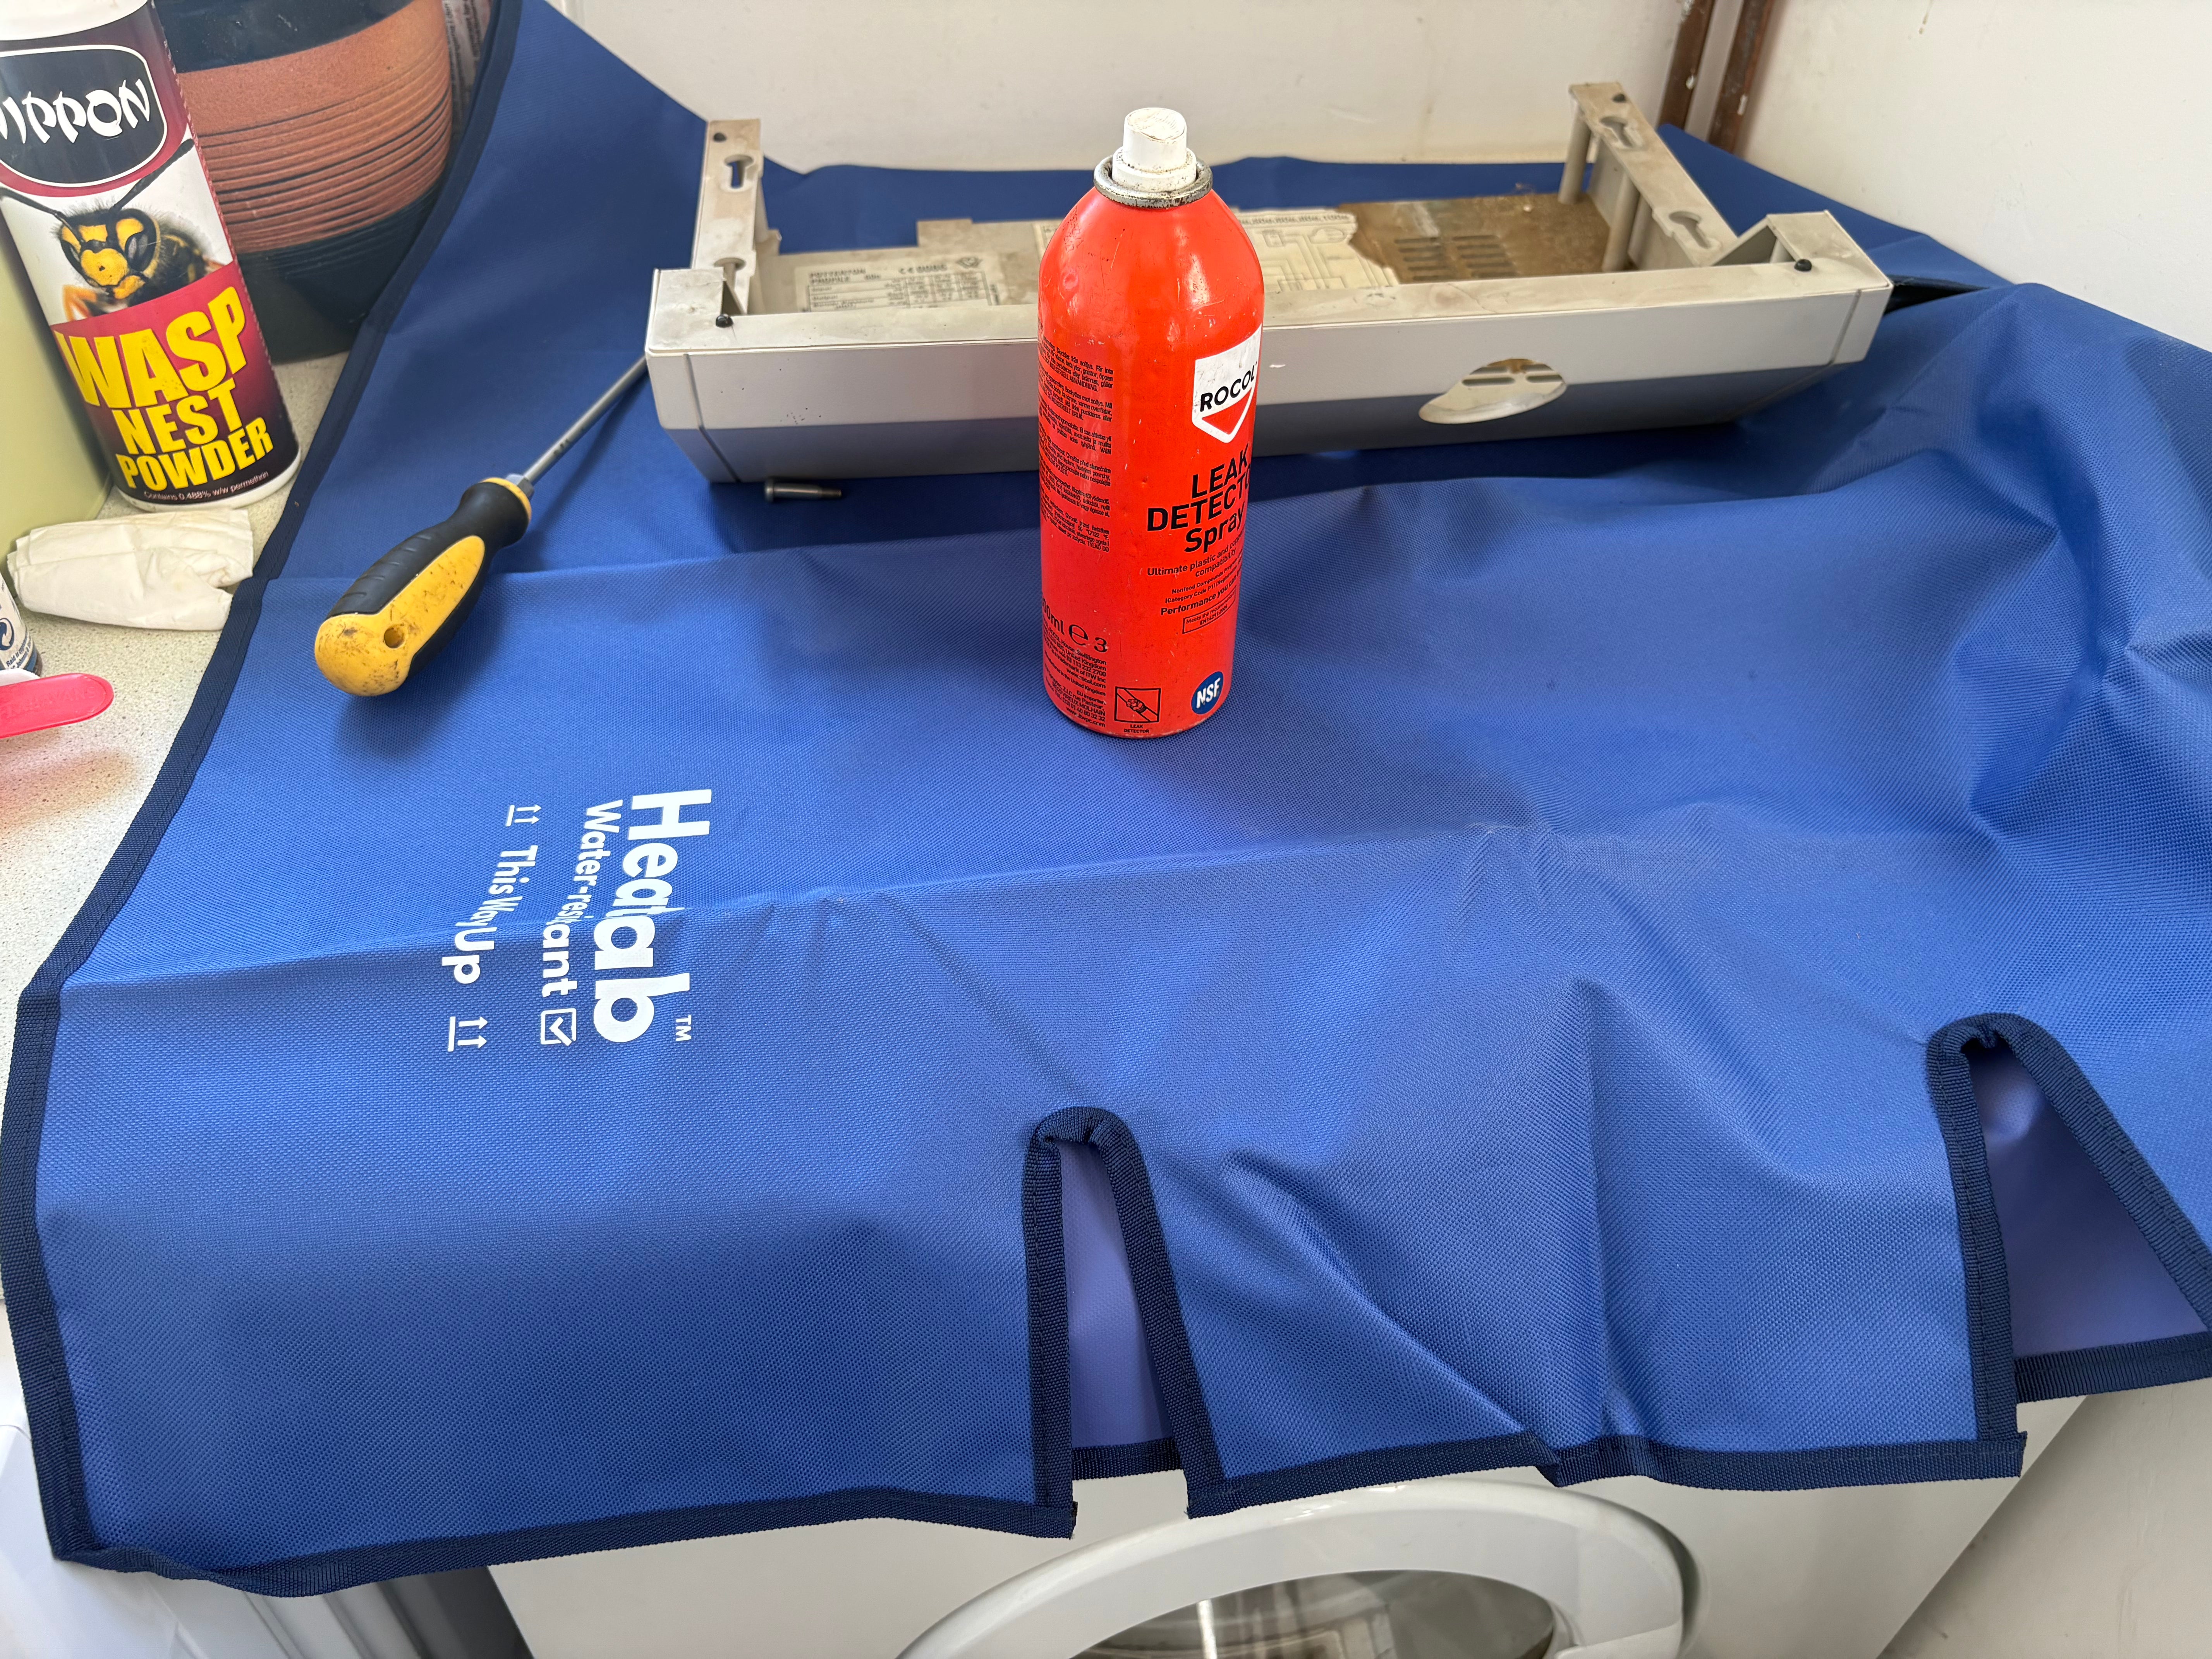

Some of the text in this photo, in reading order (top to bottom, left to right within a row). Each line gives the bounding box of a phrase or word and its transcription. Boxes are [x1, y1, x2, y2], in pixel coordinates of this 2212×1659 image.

[0, 79, 150, 144] IPPON
[54, 287, 246, 409] WASP
[1200, 364, 1254, 412] ROCOL
[112, 378, 242, 455] NEST
[115, 417, 273, 492] POWDER
[1191, 442, 1249, 499] LEAK
[1147, 464, 1251, 532] DETECTO
[1183, 501, 1245, 554] Spray
[1147, 562, 1188, 576] Ultimate
[1190, 551, 1215, 572] plastic
[1217, 544, 1228, 560] and
[1195, 544, 1235, 579] compatibility
[1160, 591, 1216, 615] Performance
[1217, 583, 1228, 599] you
[1171, 583, 1195, 595] Nonfood
[1194, 587, 1206, 598] Code
[1094, 637, 1108, 653] 3
[1196, 677, 1221, 709] NSF
[442, 845, 538, 984] This Way Up
